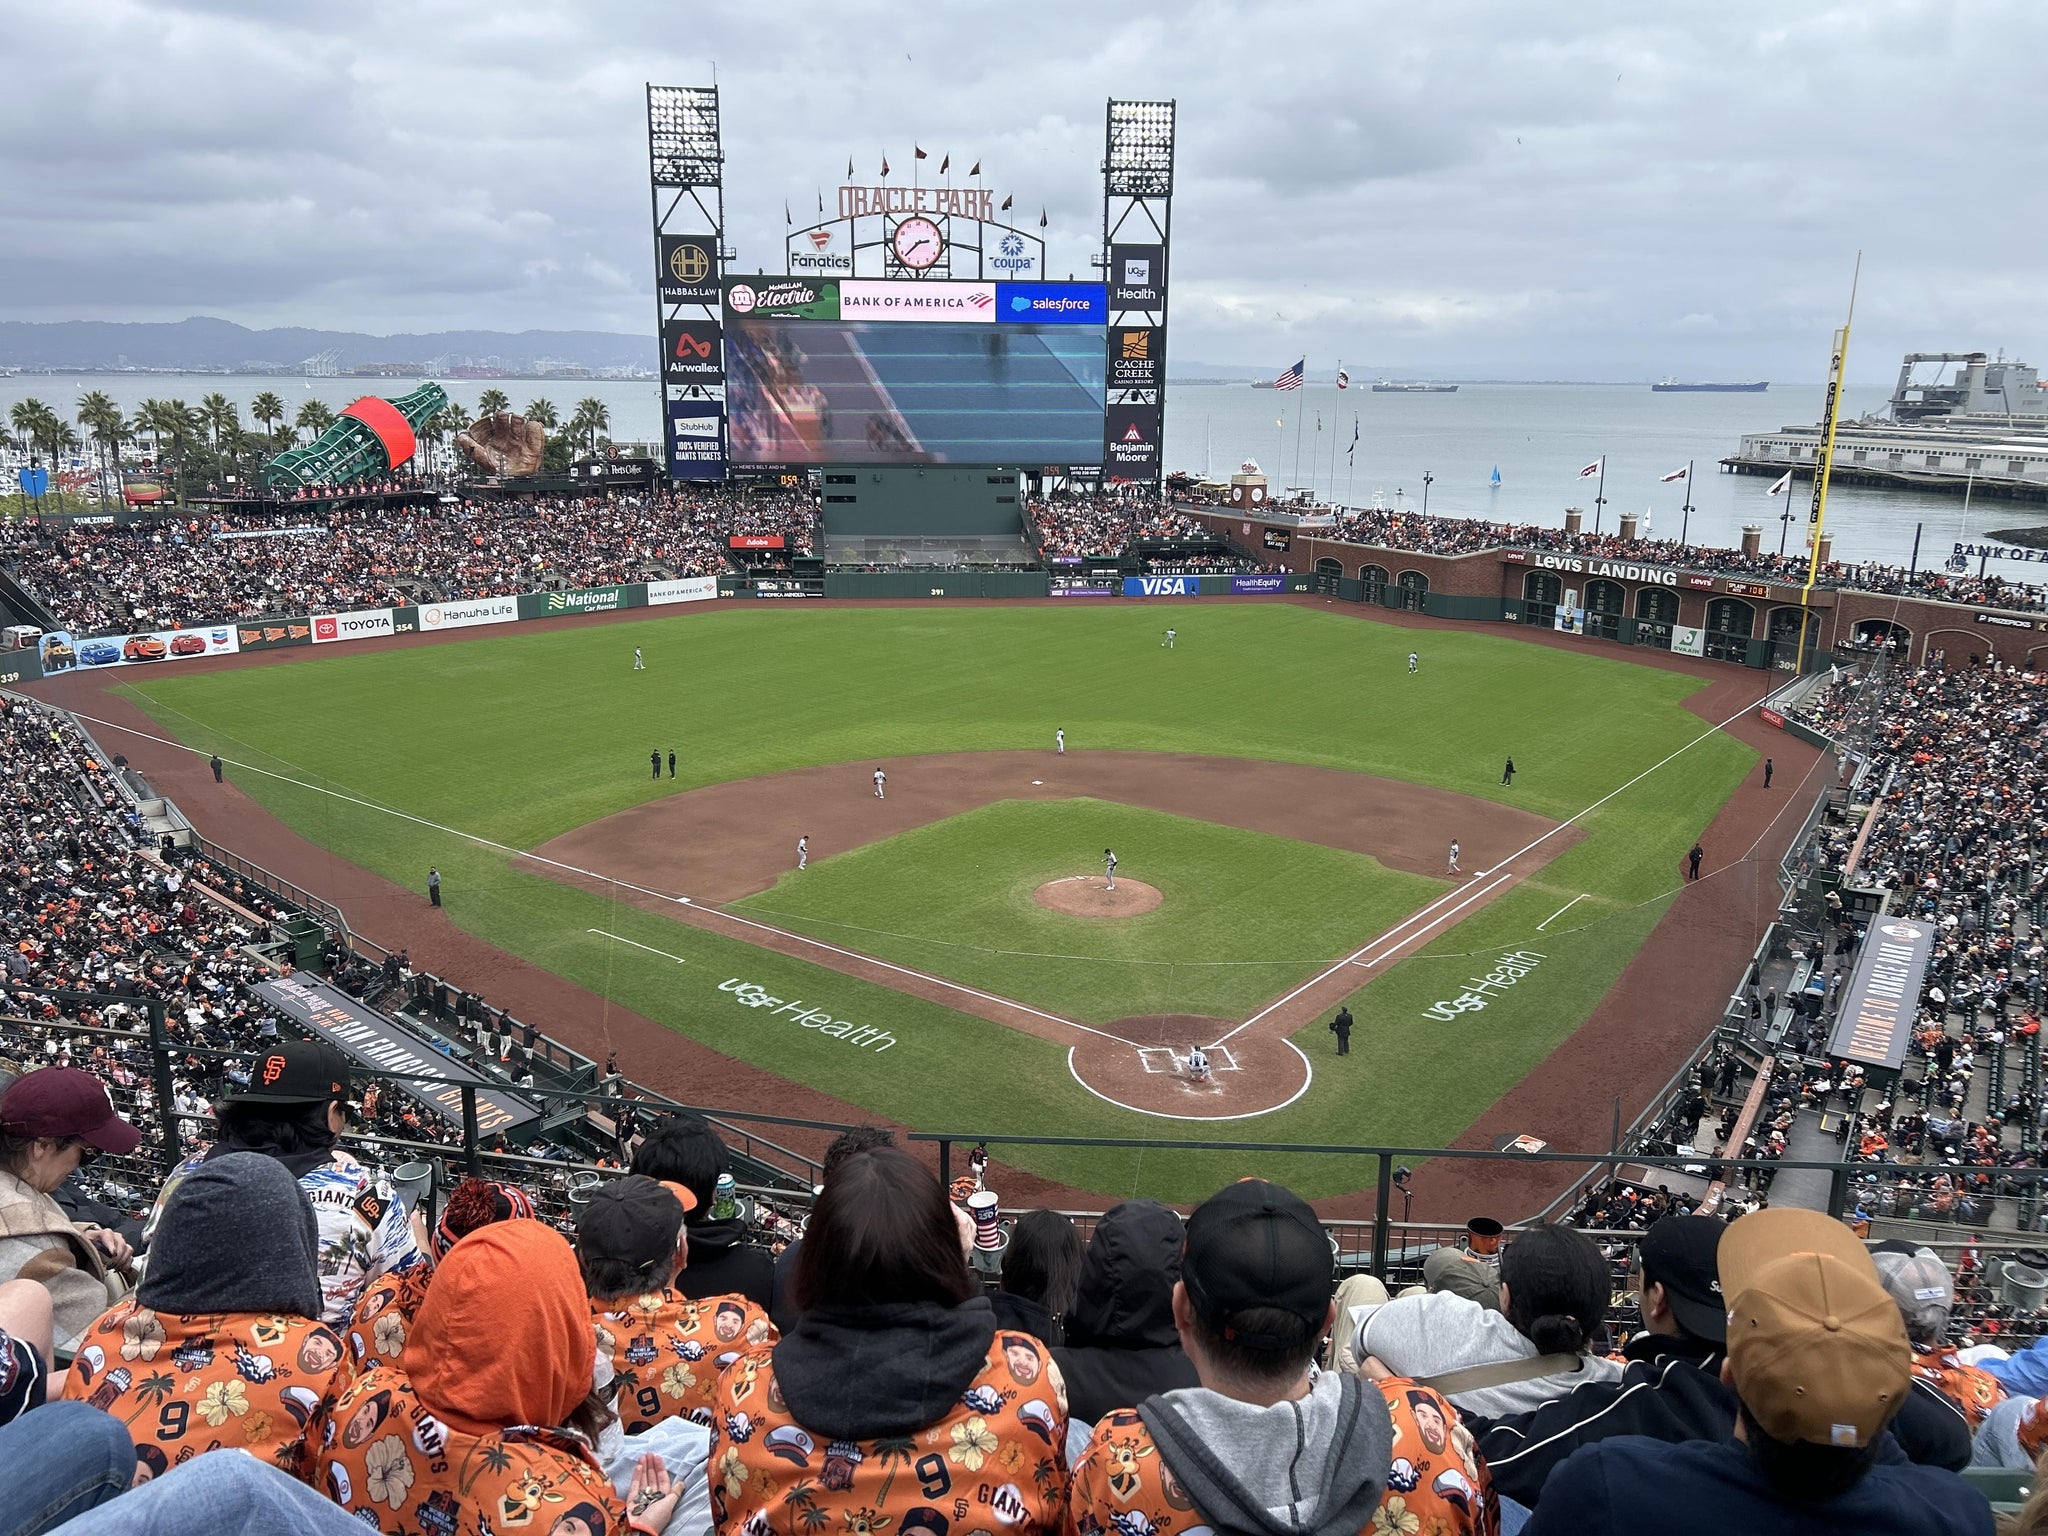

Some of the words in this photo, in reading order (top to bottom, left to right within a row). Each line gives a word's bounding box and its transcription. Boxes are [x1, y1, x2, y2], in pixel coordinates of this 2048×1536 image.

[839, 186, 926, 220] ORACLE
[934, 188, 994, 223] PARK
[791, 253, 850, 268] Fanatics
[994, 258, 1031, 270] coupa
[1127, 267, 1147, 277] UCSF
[756, 288, 815, 307] Electric
[1117, 288, 1156, 299] Health
[844, 296, 881, 306] BANK
[884, 297, 901, 307] OF
[904, 297, 964, 307] AMERICA
[1033, 297, 1090, 312] salesforce
[670, 363, 719, 373] Airwallex
[1114, 360, 1155, 369] CACHE
[1115, 369, 1153, 377] CREEK
[1821, 382, 1836, 447] CHIKIN
[680, 422, 714, 431] StubHub
[677, 442, 693, 450] 100%
[693, 441, 719, 450] VERIFIED
[1110, 442, 1154, 454] Benjamin
[675, 451, 697, 460] GIANTS
[697, 451, 721, 460] TICKETS
[1116, 453, 1148, 461] Moore
[625, 464, 642, 475] Coffee
[1817, 453, 1825, 474] IZ
[781, 475, 797, 485] 0:59
[1810, 481, 1822, 523] FARE
[1954, 543, 2004, 558] BANK
[2011, 549, 2035, 560] OF
[1588, 561, 1677, 586] LANDING
[1139, 578, 1186, 595] VISA
[1236, 579, 1282, 587] HealthEquity
[565, 589, 619, 607] National
[674, 588, 702, 596] AMERICA
[444, 609, 490, 621] Hanwha
[492, 605, 513, 617] Life
[585, 604, 597, 612] Car
[598, 602, 617, 610] Rental
[1505, 612, 1517, 620] 365
[341, 618, 390, 631] TOYOTA
[396, 623, 413, 632] 354
[1779, 661, 1796, 671] 309
[1, 672, 19, 684] 339
[1876, 942, 1915, 966] PARK
[1460, 951, 1547, 997] Health
[1866, 964, 1909, 999] ORACLE
[1863, 997, 1900, 1012] TO
[325, 1008, 354, 1023] HOME
[718, 977, 784, 1008] UCSF
[770, 1000, 897, 1052] Health
[1848, 1010, 1897, 1060] WELCOME
[329, 1020, 378, 1043] SAN
[357, 1037, 449, 1092] FRANCISCO
[263, 1055, 286, 1086] SF
[360, 1196, 380, 1219] SF
[175, 1353, 211, 1363] CHAMPIONS
[636, 1386, 661, 1417] 9
[156, 1401, 190, 1441] 9
[410, 1405, 448, 1474] GIANTS
[827, 1448, 862, 1462] CHAMPIONS
[915, 1452, 952, 1500] 9
